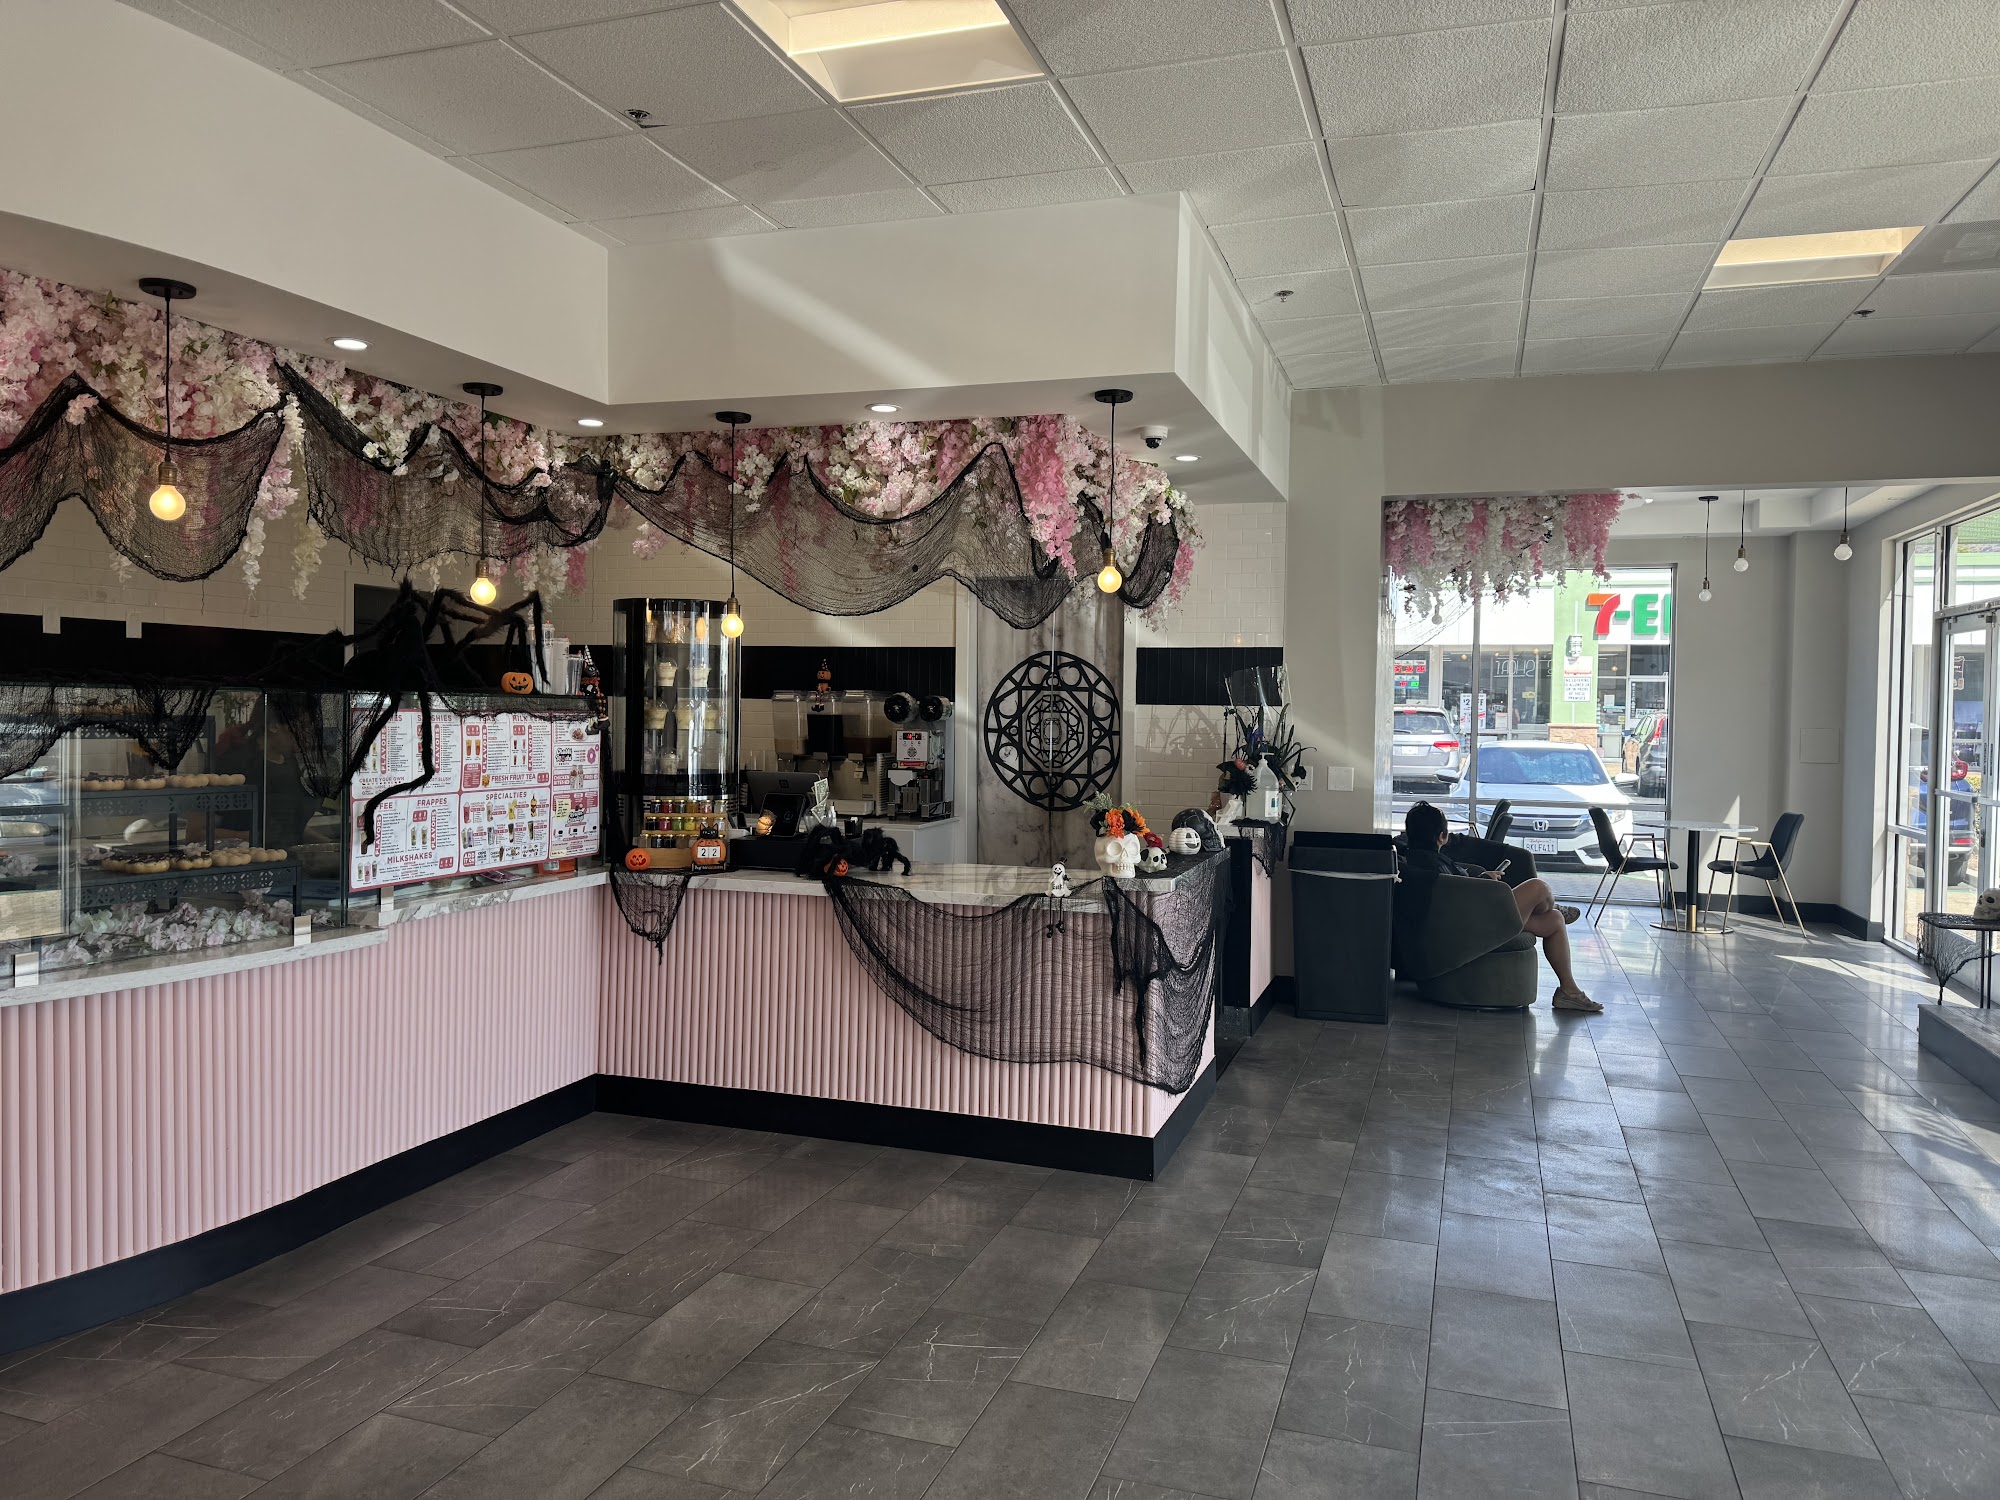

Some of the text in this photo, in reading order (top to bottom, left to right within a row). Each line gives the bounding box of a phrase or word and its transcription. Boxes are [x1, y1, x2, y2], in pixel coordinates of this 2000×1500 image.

[417, 714, 452, 722] SSHIES
[485, 792, 527, 800] SPECIALTIES
[417, 797, 448, 807] FRAPPES
[374, 815, 383, 856] FLAVORS
[1526, 843, 1555, 852] 8KLF411
[387, 852, 433, 864] MILKSHAKES
